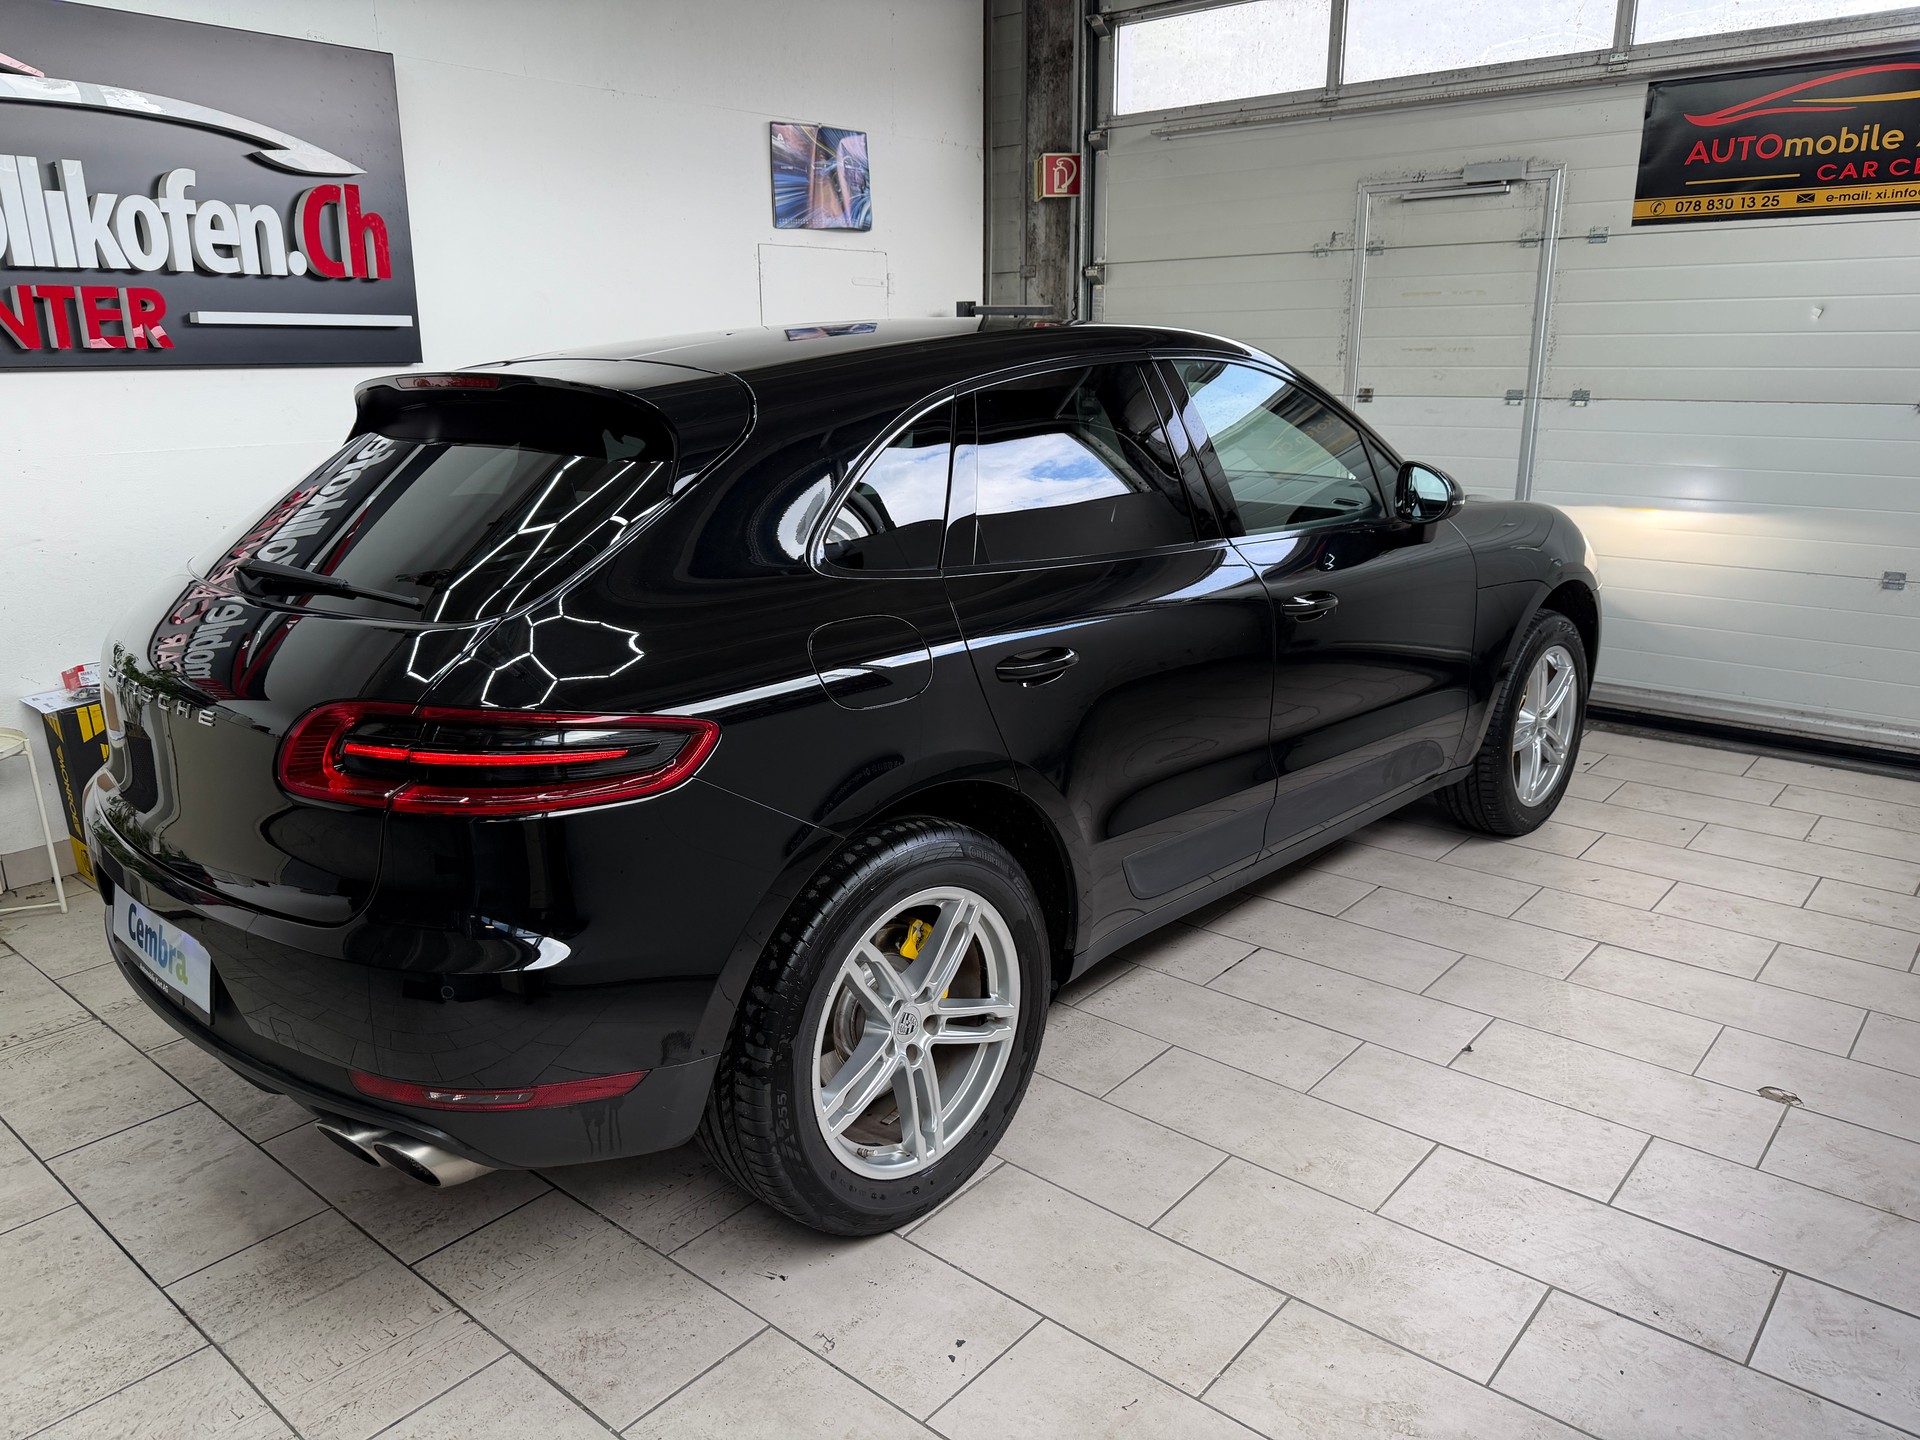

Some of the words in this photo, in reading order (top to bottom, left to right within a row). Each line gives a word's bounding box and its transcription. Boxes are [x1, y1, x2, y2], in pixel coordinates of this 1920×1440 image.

[1684, 123, 1905, 166] AUTOmobile
[1816, 161, 1880, 181] CAR
[0, 154, 393, 280] llikofen.Ch
[1675, 200, 1702, 213] 078
[1706, 198, 1734, 211] 830
[1741, 197, 1756, 209] 13
[1761, 195, 1780, 208] 25
[1826, 190, 1873, 203] e-mail:
[1876, 187, 1920, 200] xi.info
[107, 664, 216, 728] PORSCHE
[128, 903, 189, 986] Cembra
